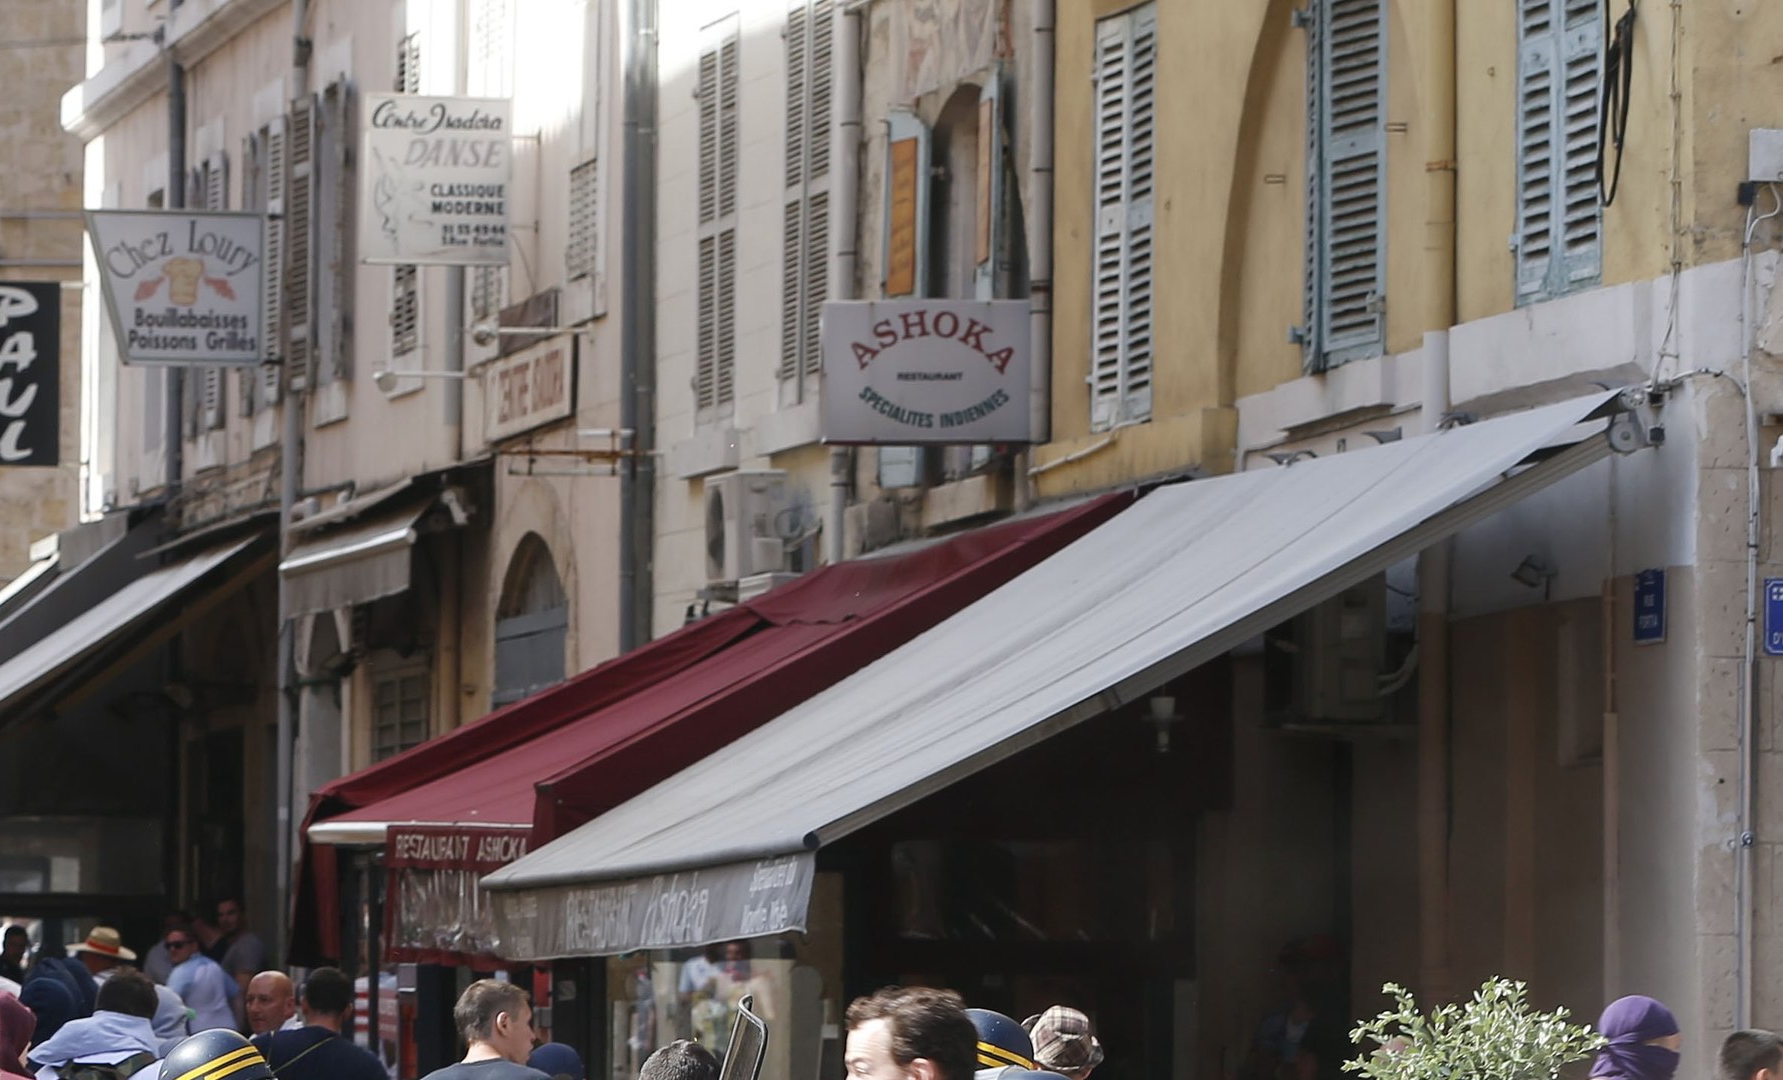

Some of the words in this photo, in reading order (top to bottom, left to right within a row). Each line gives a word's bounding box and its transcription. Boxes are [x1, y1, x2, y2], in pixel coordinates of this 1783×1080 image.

[404, 138, 505, 169] DANSE
[430, 183, 506, 199] CLASSIQUE
[431, 201, 505, 216] MODERNE
[105, 231, 173, 279] Chez
[187, 219, 260, 278] Loury
[133, 307, 248, 330] Bouillabaisses
[128, 329, 197, 350] Poissons
[851, 309, 1015, 375] ASHOKA
[896, 371, 964, 382] RESTAURANT
[858, 385, 934, 430] SPECIALITES
[939, 387, 1011, 429] INDIENNES
[394, 834, 470, 861] RESTAURANT
[475, 836, 527, 863] ASHOKA
